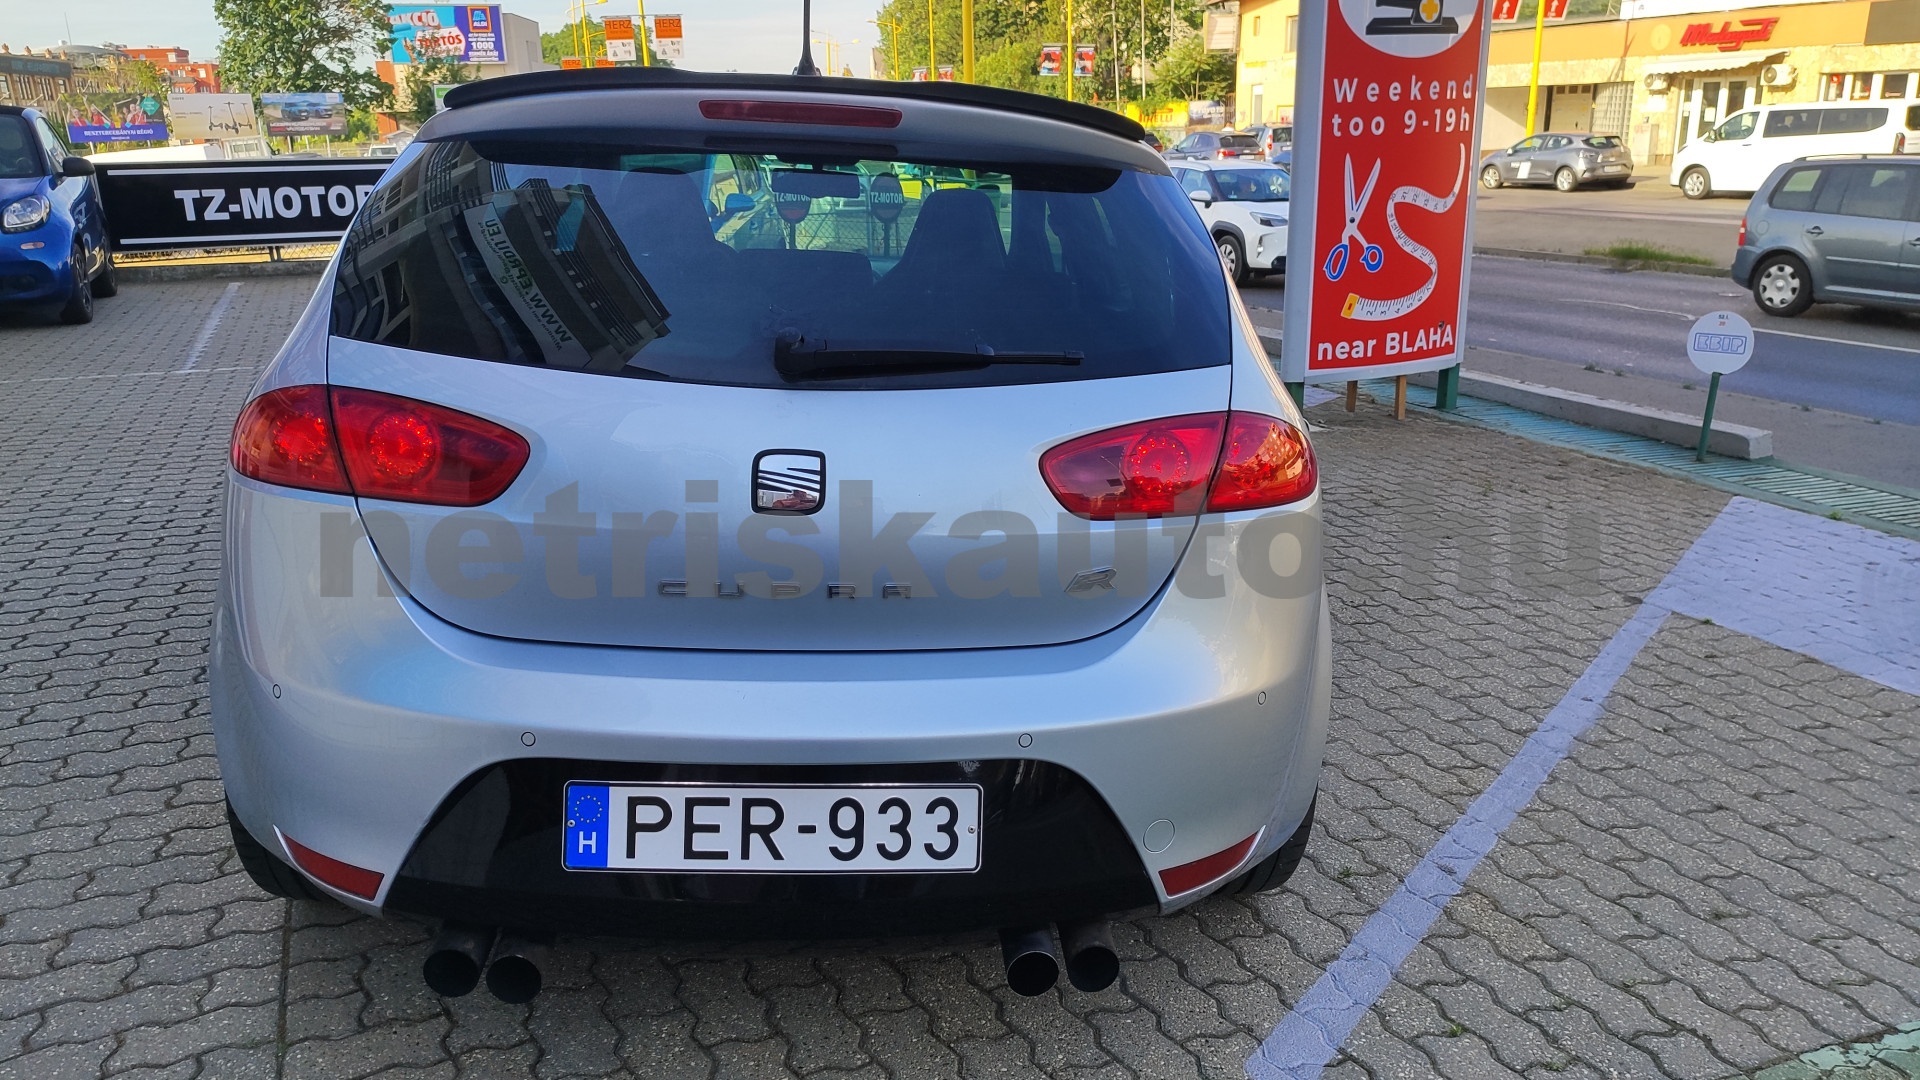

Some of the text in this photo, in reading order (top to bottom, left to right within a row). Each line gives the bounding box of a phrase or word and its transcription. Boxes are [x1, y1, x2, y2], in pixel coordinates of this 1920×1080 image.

[605, 20, 631, 29] HERZ
[655, 19, 680, 28] HERZ
[471, 42, 495, 50] 1000
[1333, 73, 1474, 103] Weekend
[1332, 106, 1470, 137] too 9-19h
[870, 192, 904, 204] TZ-MOTOR
[1317, 324, 1453, 361] near BLAHA
[657, 580, 912, 599] CUPRA
[625, 795, 960, 862] PER-933
[578, 830, 597, 854] H
